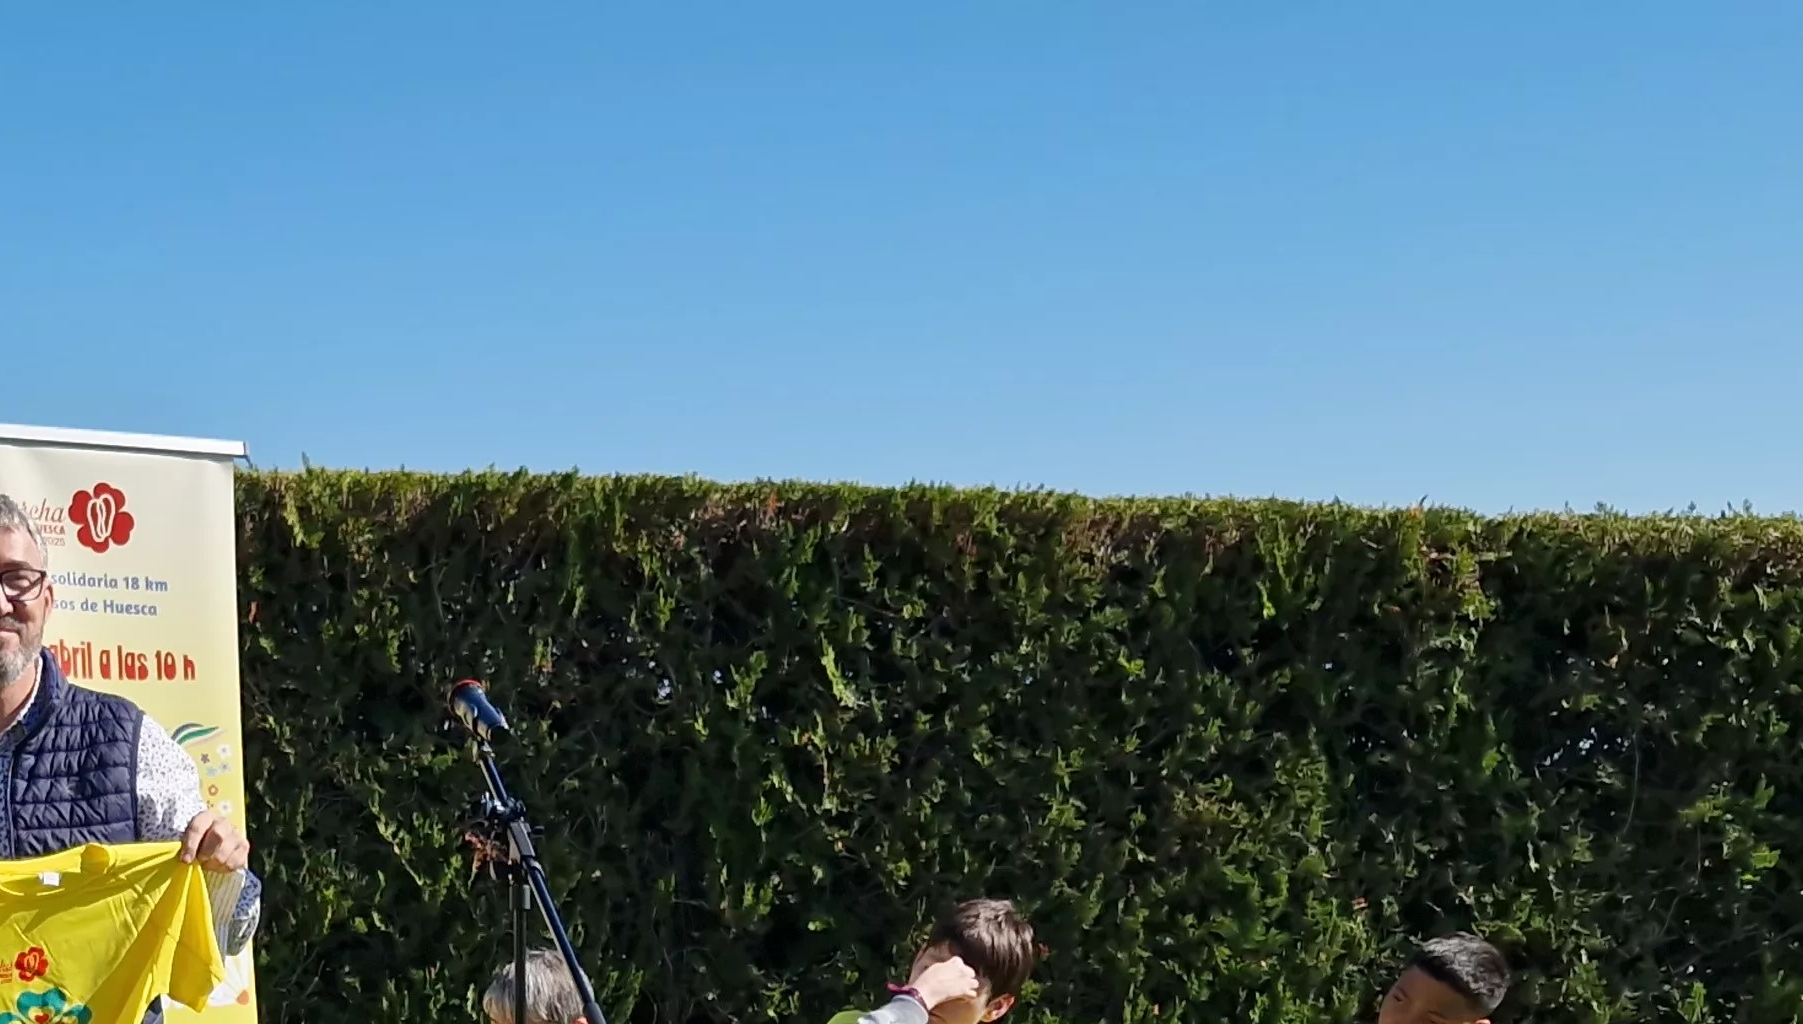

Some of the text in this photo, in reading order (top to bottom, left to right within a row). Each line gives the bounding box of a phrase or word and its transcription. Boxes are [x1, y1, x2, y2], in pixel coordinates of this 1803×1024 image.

[51, 572, 168, 591] solidaria 18 km
[80, 598, 98, 612] de
[103, 600, 158, 616] Huesca
[99, 649, 112, 680] a
[117, 645, 149, 681] las
[155, 650, 177, 681] 10
[183, 654, 196, 681] h
